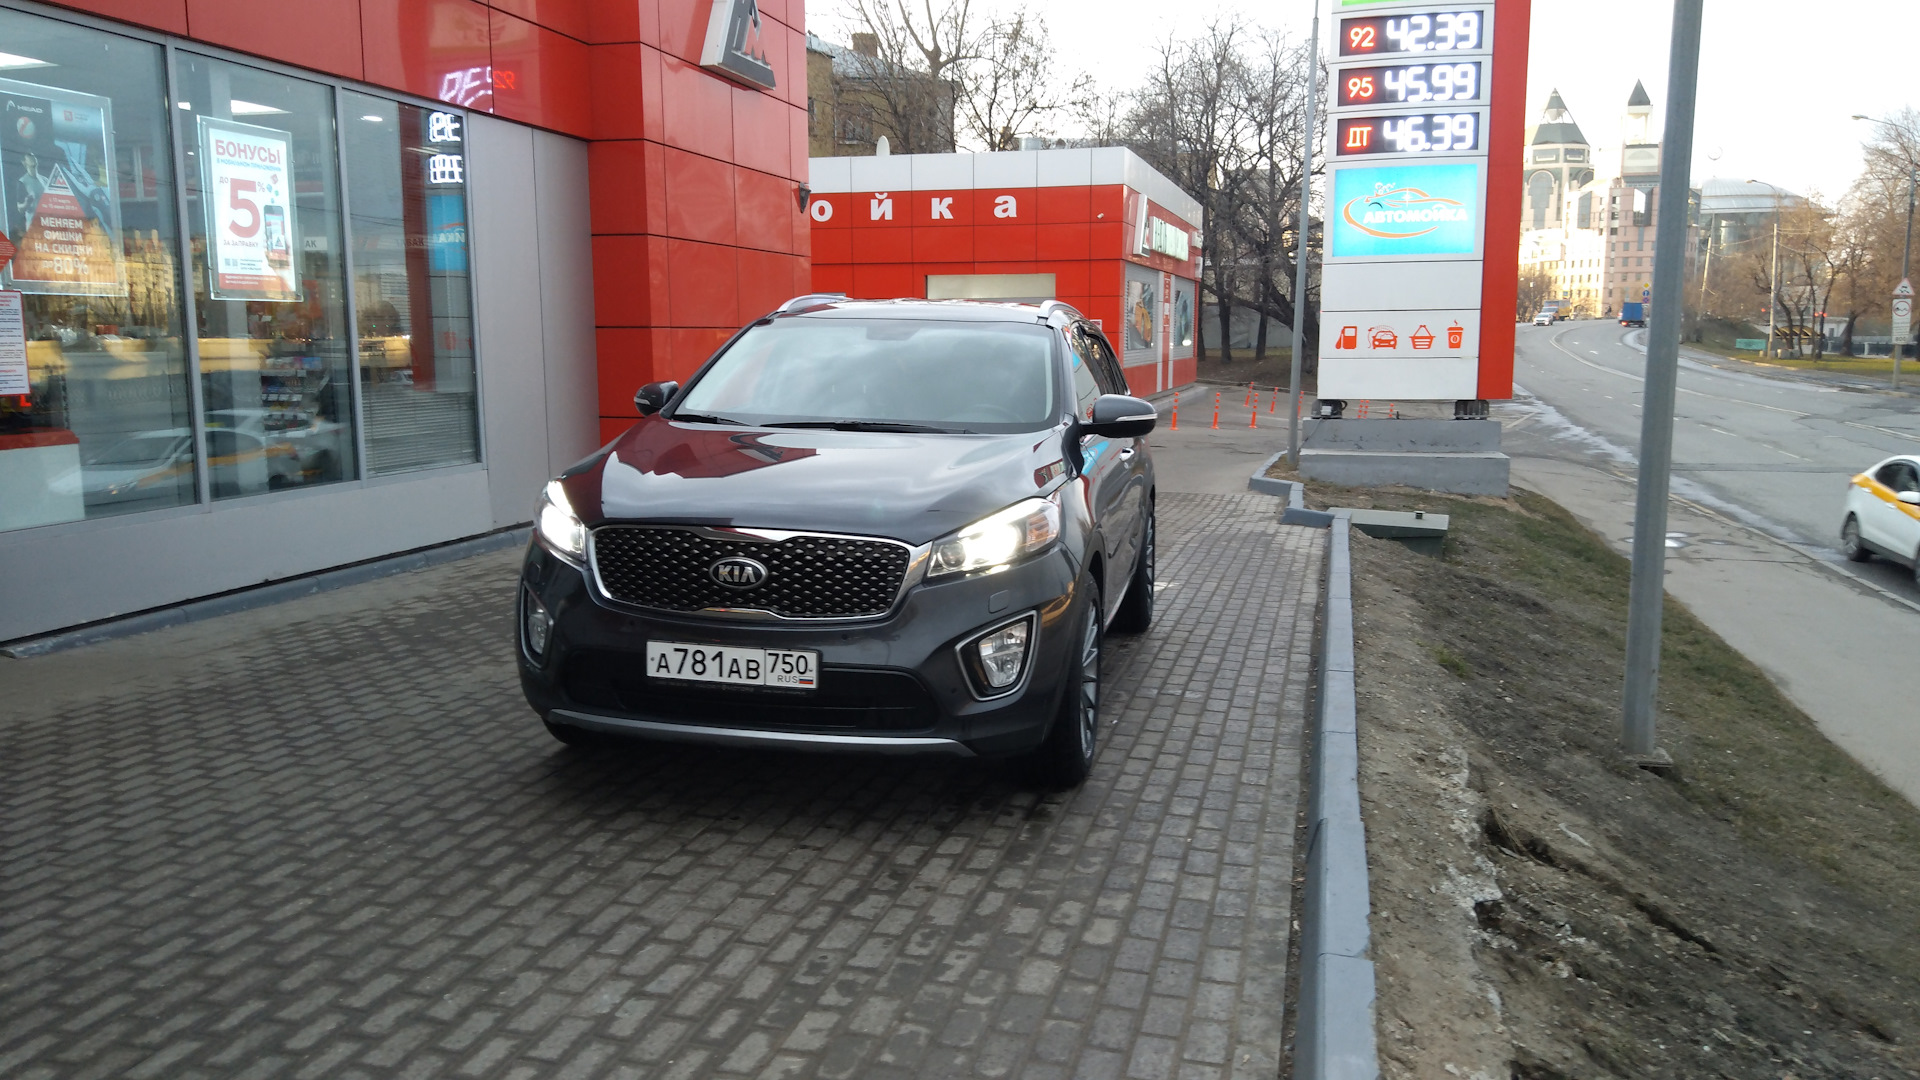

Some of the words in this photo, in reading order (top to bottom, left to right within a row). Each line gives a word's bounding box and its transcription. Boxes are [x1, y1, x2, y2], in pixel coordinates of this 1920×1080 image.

[1350, 27, 1375, 48] 92
[1386, 12, 1479, 52] 42.39
[1348, 77, 1373, 98] 95
[1384, 63, 1476, 103] 45.99
[1346, 126, 1372, 147] ДТ
[1383, 114, 1475, 152] 46.39
[215, 139, 281, 165] БОНУСЫ
[40, 216, 83, 229] МЕНЯЕМ
[1363, 203, 1469, 224] АВТОМОЙКА
[43, 230, 83, 243] ФИШКИ
[34, 242, 50, 253] НА
[52, 243, 93, 257] СКИДКИ
[53, 256, 89, 275] 80%
[718, 564, 756, 583] KIA
[656, 648, 760, 680] А781АВ
[767, 652, 808, 675] 750
[777, 674, 798, 684] RUS
